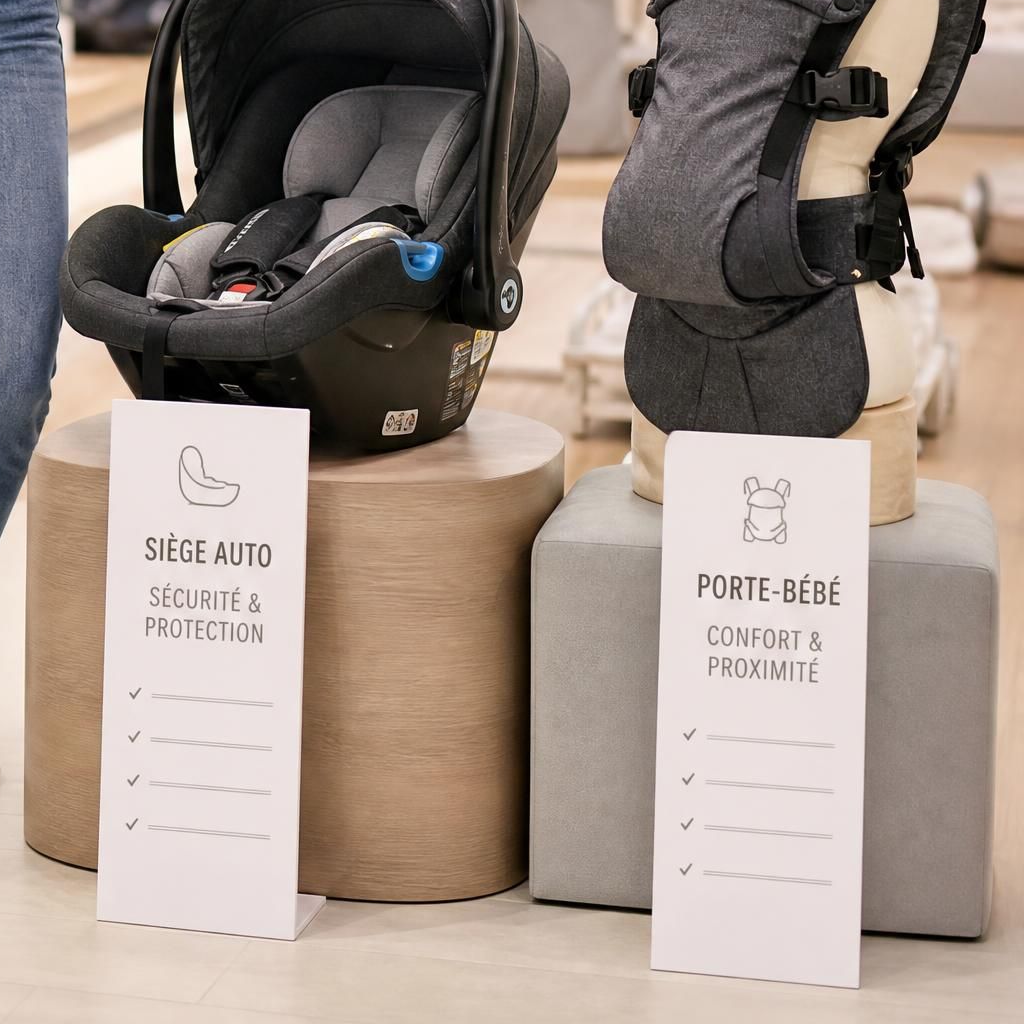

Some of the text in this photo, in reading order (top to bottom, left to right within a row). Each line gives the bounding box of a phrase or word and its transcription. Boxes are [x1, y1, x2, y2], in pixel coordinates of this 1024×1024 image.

[145, 533, 271, 567] SIÈGE AUTO
[150, 583, 261, 613] SÉCURITÉ &
[698, 574, 840, 606] PORTE-BÉBÉ
[146, 617, 263, 643] PROTECTION
[708, 626, 822, 651] CONFORT &
[709, 656, 818, 683] PROXIMITÉ
